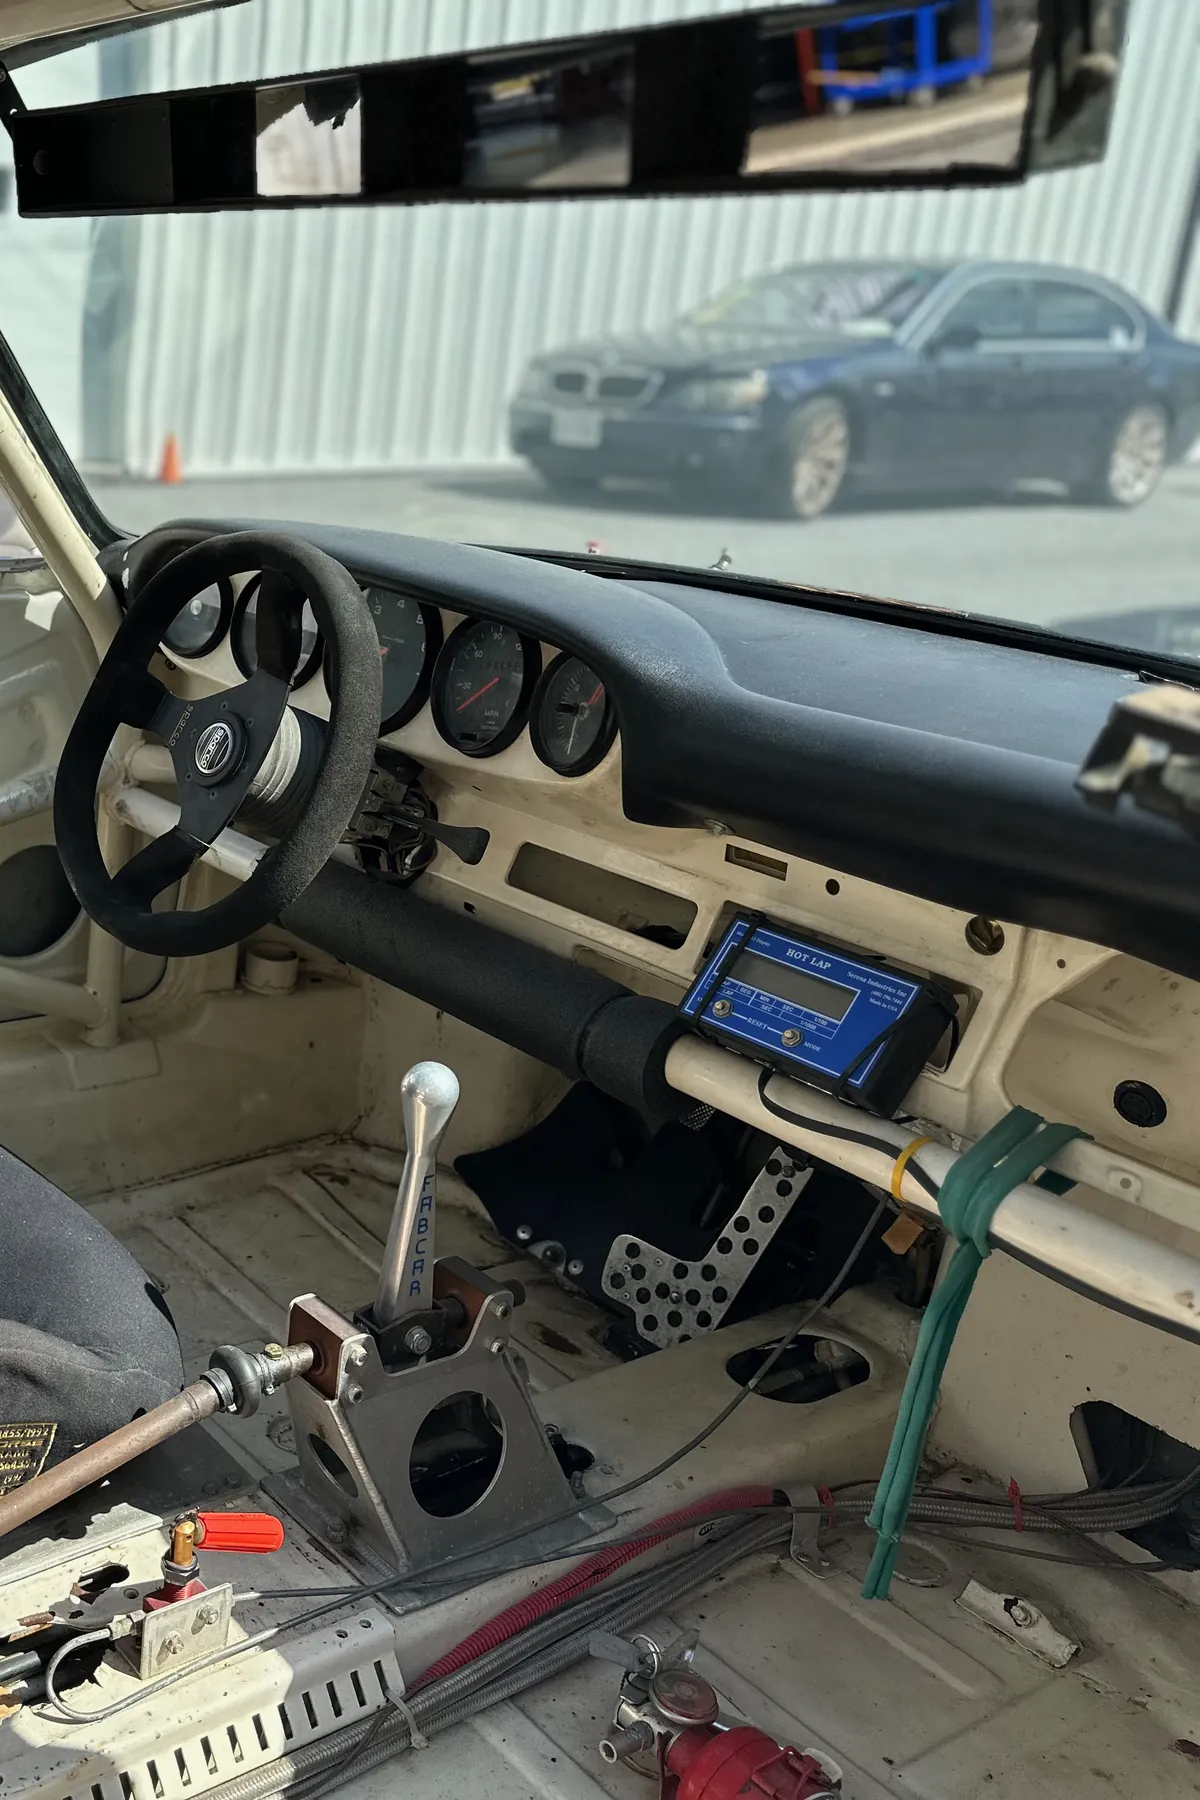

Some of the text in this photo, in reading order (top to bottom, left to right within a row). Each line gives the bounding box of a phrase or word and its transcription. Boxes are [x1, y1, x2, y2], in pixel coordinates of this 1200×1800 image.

[396, 599, 406, 609] 4
[374, 605, 382, 615] 3
[492, 632, 502, 640] 90
[474, 650, 483, 658] 60
[462, 682, 472, 690] 30
[786, 948, 832, 970] HOT LAP
[846, 971, 908, 998] Serena Industries Inc
[740, 987, 752, 996] SEG
[782, 1004, 794, 1012] SEC
[814, 1016, 828, 1026] 1/100
[869, 998, 881, 1006] Made
[722, 988, 817, 1030] LAP SEC 1/1000
[746, 1018, 768, 1030] RESET
[804, 1041, 822, 1052] MODE
[409, 1174, 435, 1297] FABCAR
